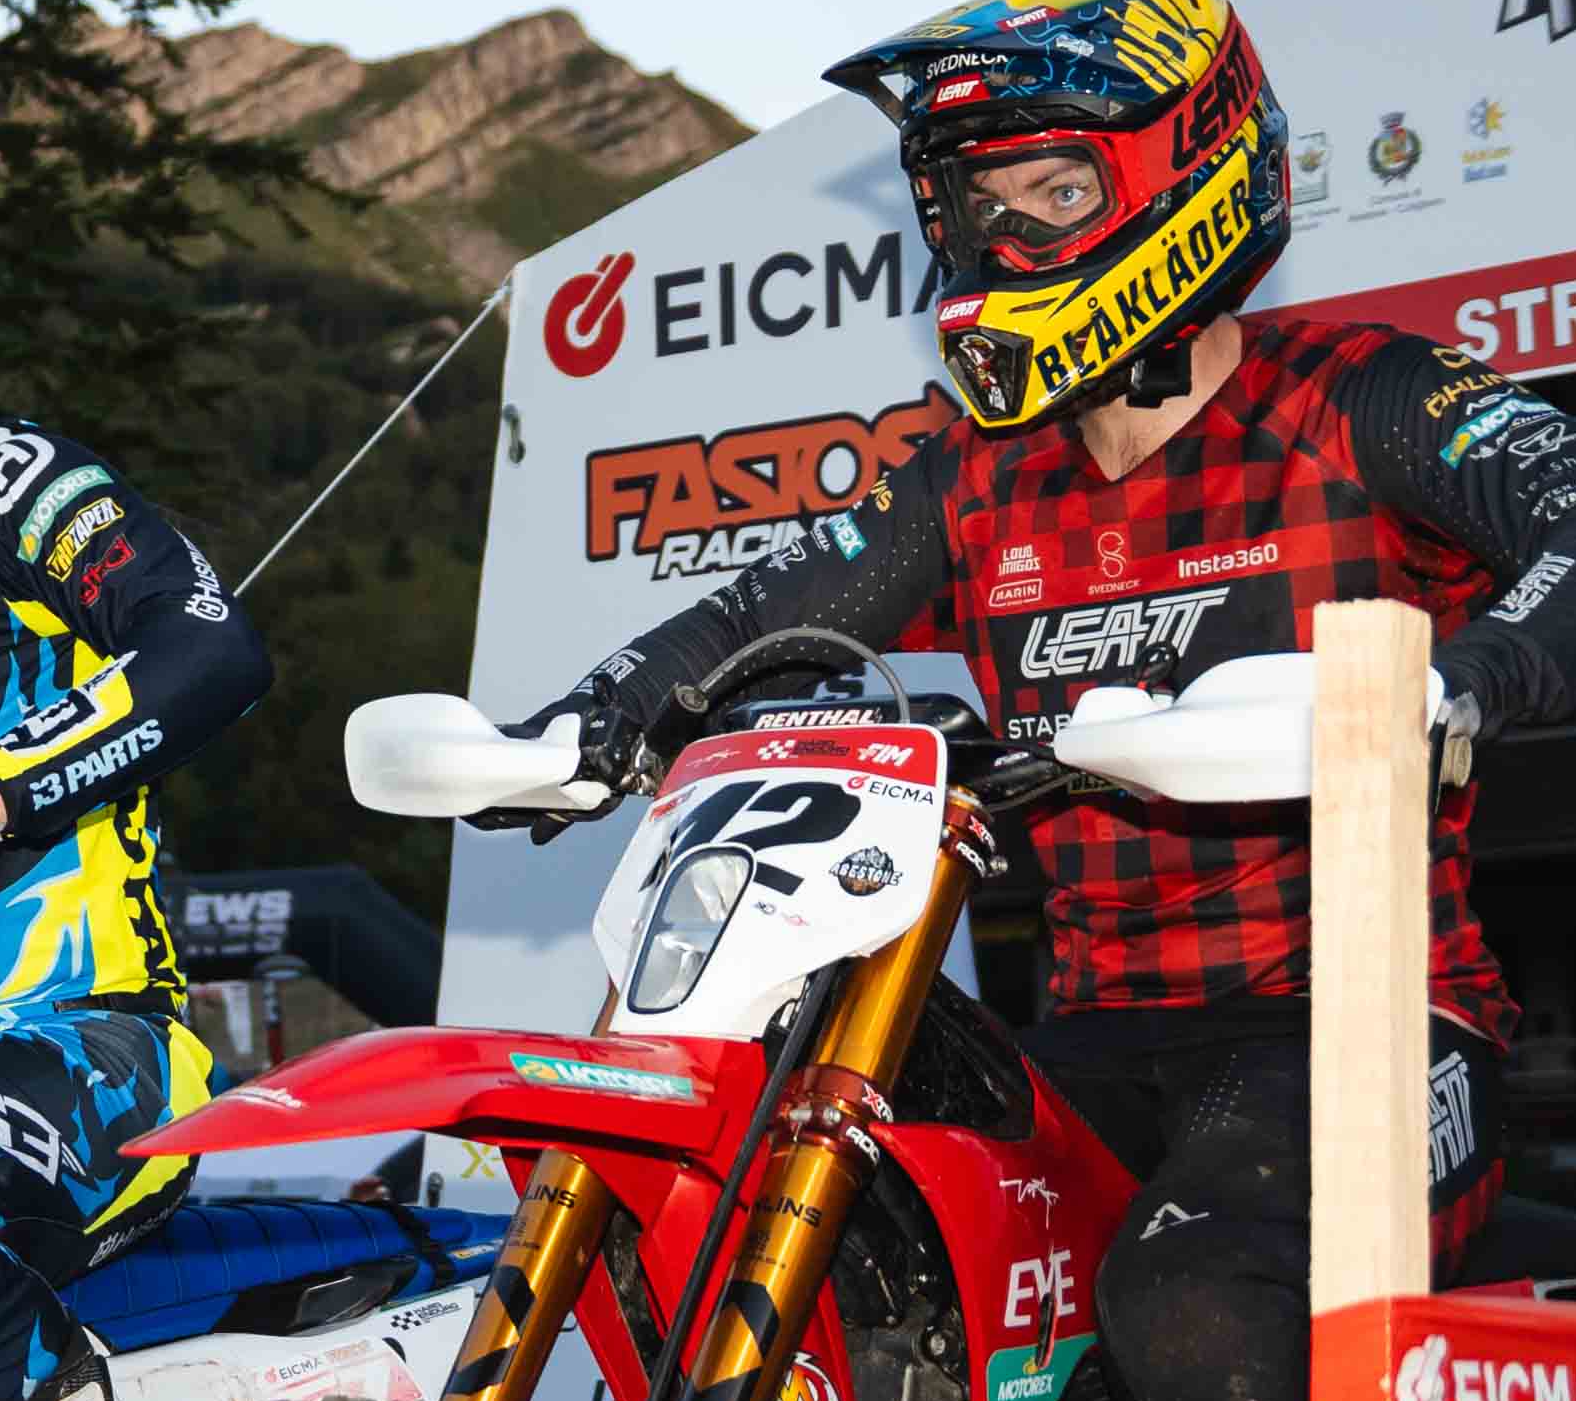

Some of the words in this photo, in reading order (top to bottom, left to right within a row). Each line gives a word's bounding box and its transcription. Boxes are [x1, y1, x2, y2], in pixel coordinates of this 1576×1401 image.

[1033, 178, 1251, 398] BLÅKLÄDER
[1178, 543, 1279, 580] Insta360
[1088, 579, 1141, 595] SVEDNECK
[1020, 586, 1231, 680] LEATT
[754, 709, 877, 729] RENTHAL
[65, 718, 164, 794] PARTS
[858, 743, 916, 767] FIM
[870, 781, 934, 807] EICMA
[829, 857, 904, 887] ABESTONE
[185, 890, 292, 926] EWS
[526, 1184, 578, 1210] LINS
